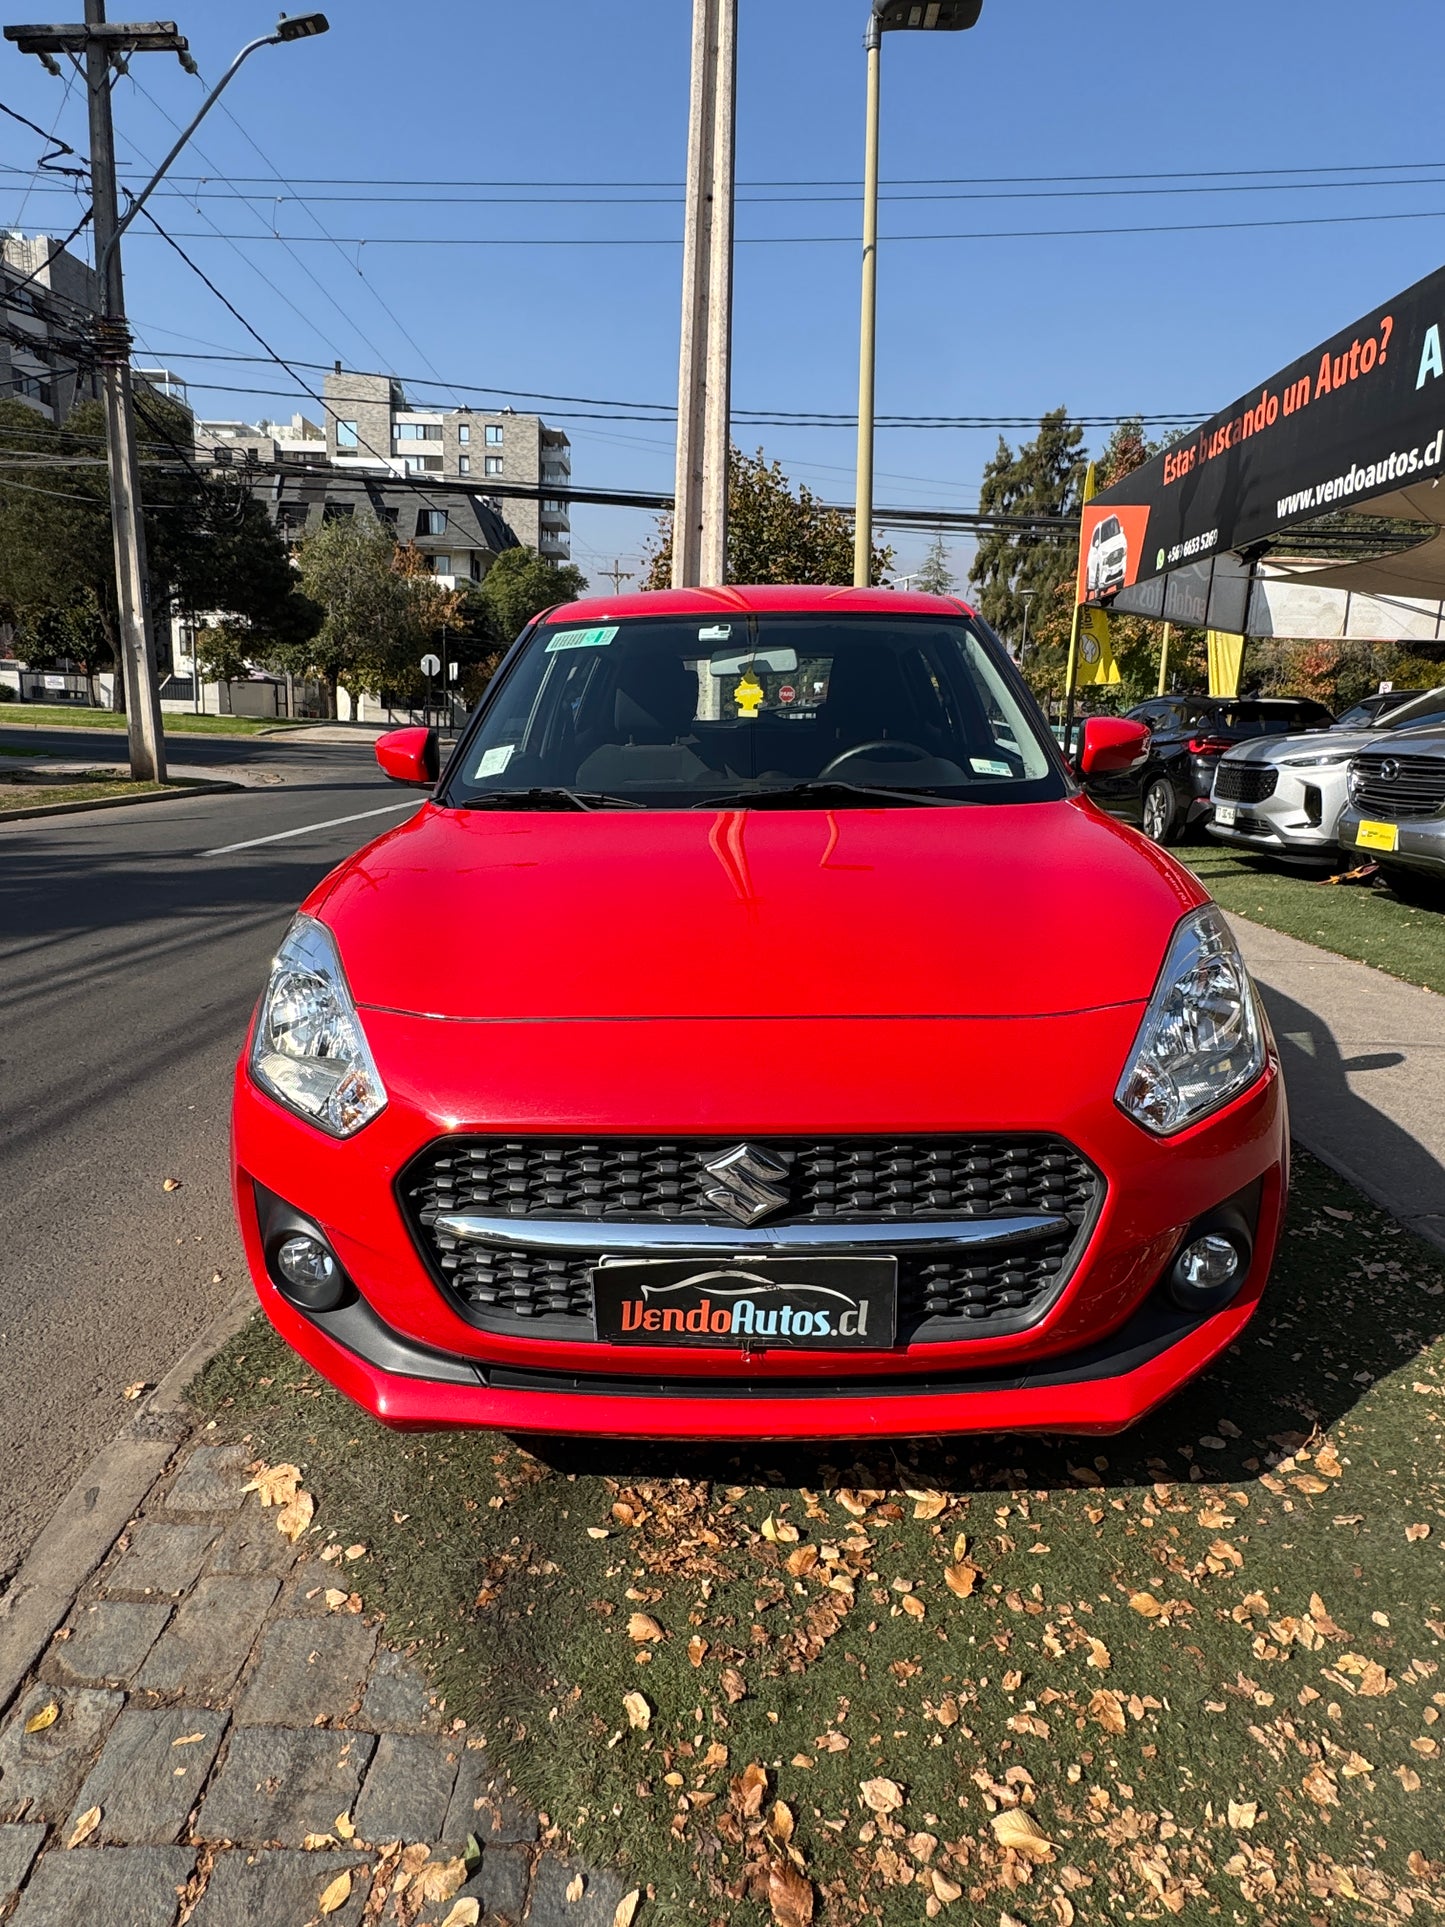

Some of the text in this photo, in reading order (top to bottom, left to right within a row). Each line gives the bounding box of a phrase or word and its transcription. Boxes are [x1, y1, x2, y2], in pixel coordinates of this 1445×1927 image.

[1162, 315, 1394, 486] Estas buscando un Auto?
[1276, 430, 1444, 519] www.vendoautos.cl
[1183, 536, 1200, 557] 6653
[621, 1299, 868, 1337] VendoAutos.cl
